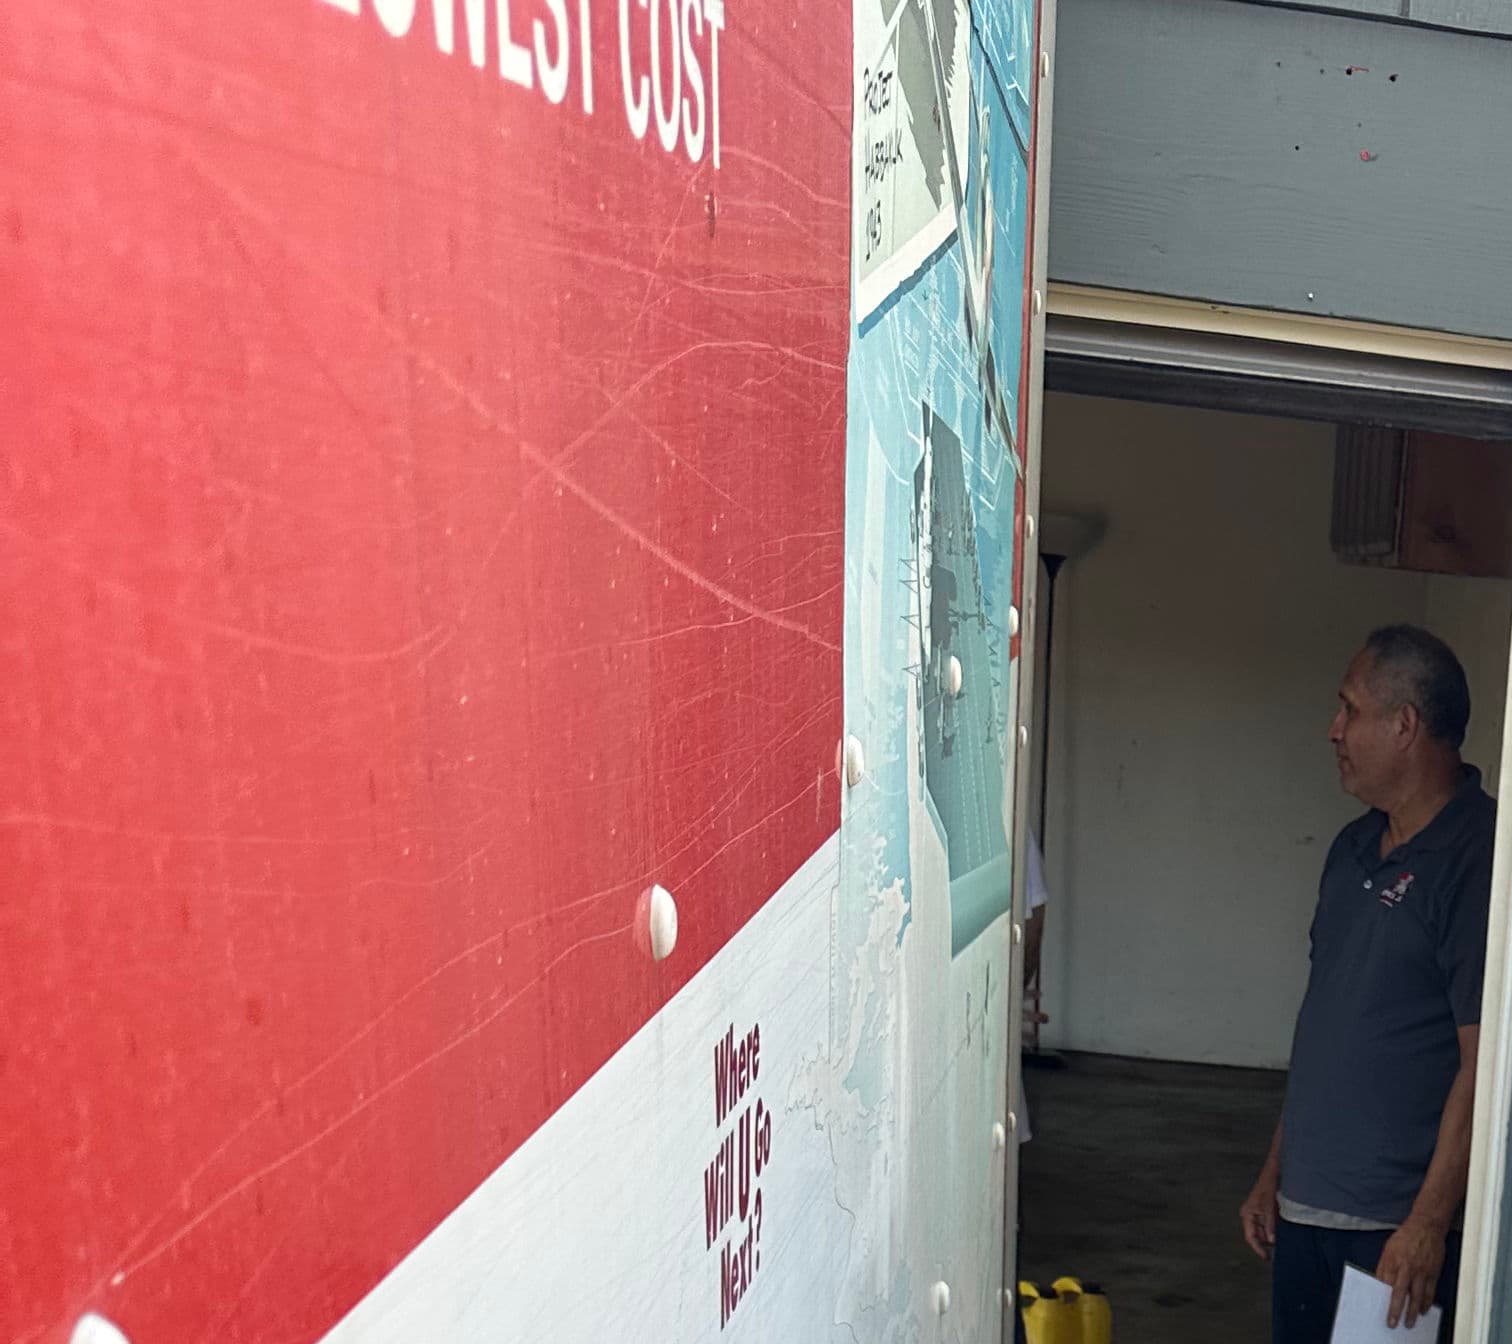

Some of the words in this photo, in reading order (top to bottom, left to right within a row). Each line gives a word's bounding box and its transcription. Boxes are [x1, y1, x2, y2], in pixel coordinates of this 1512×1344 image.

[619, 0, 725, 169] COST
[713, 1022, 760, 1128] Where
[704, 1130, 734, 1251] Will
[739, 1105, 751, 1222] U
[755, 1097, 771, 1177] Go
